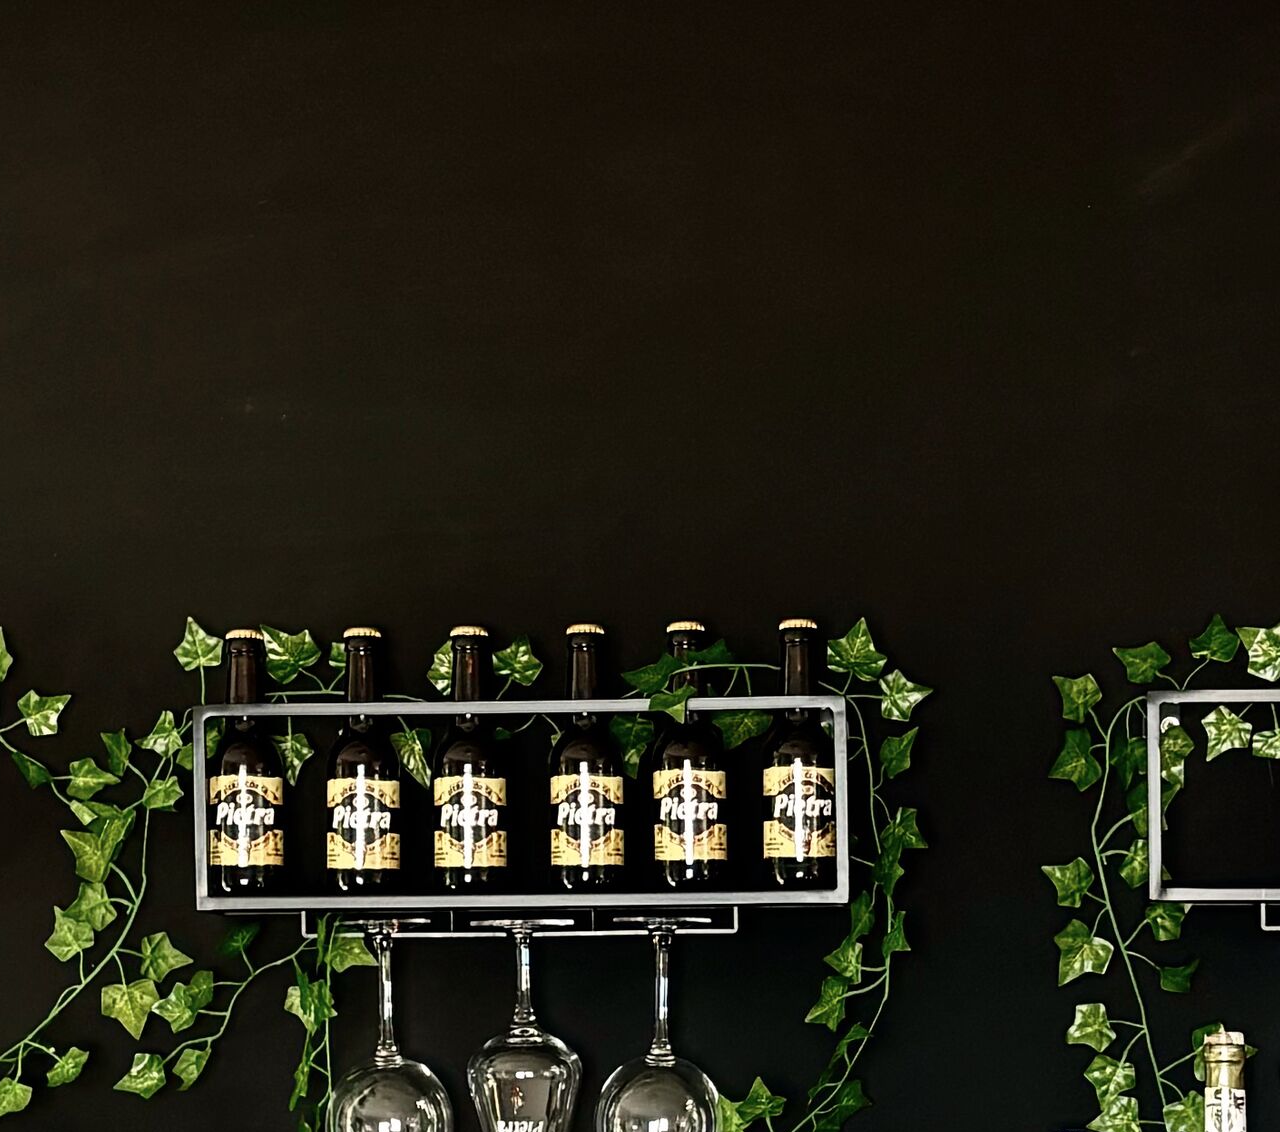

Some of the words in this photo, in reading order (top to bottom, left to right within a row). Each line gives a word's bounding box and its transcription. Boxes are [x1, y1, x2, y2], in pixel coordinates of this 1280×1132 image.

[216, 802, 275, 825] Pietra
[332, 805, 391, 829] Pietra
[440, 803, 499, 827] Pietra
[557, 801, 616, 825] Pietra
[660, 797, 718, 821] Pietra
[774, 794, 832, 818] Pietra
